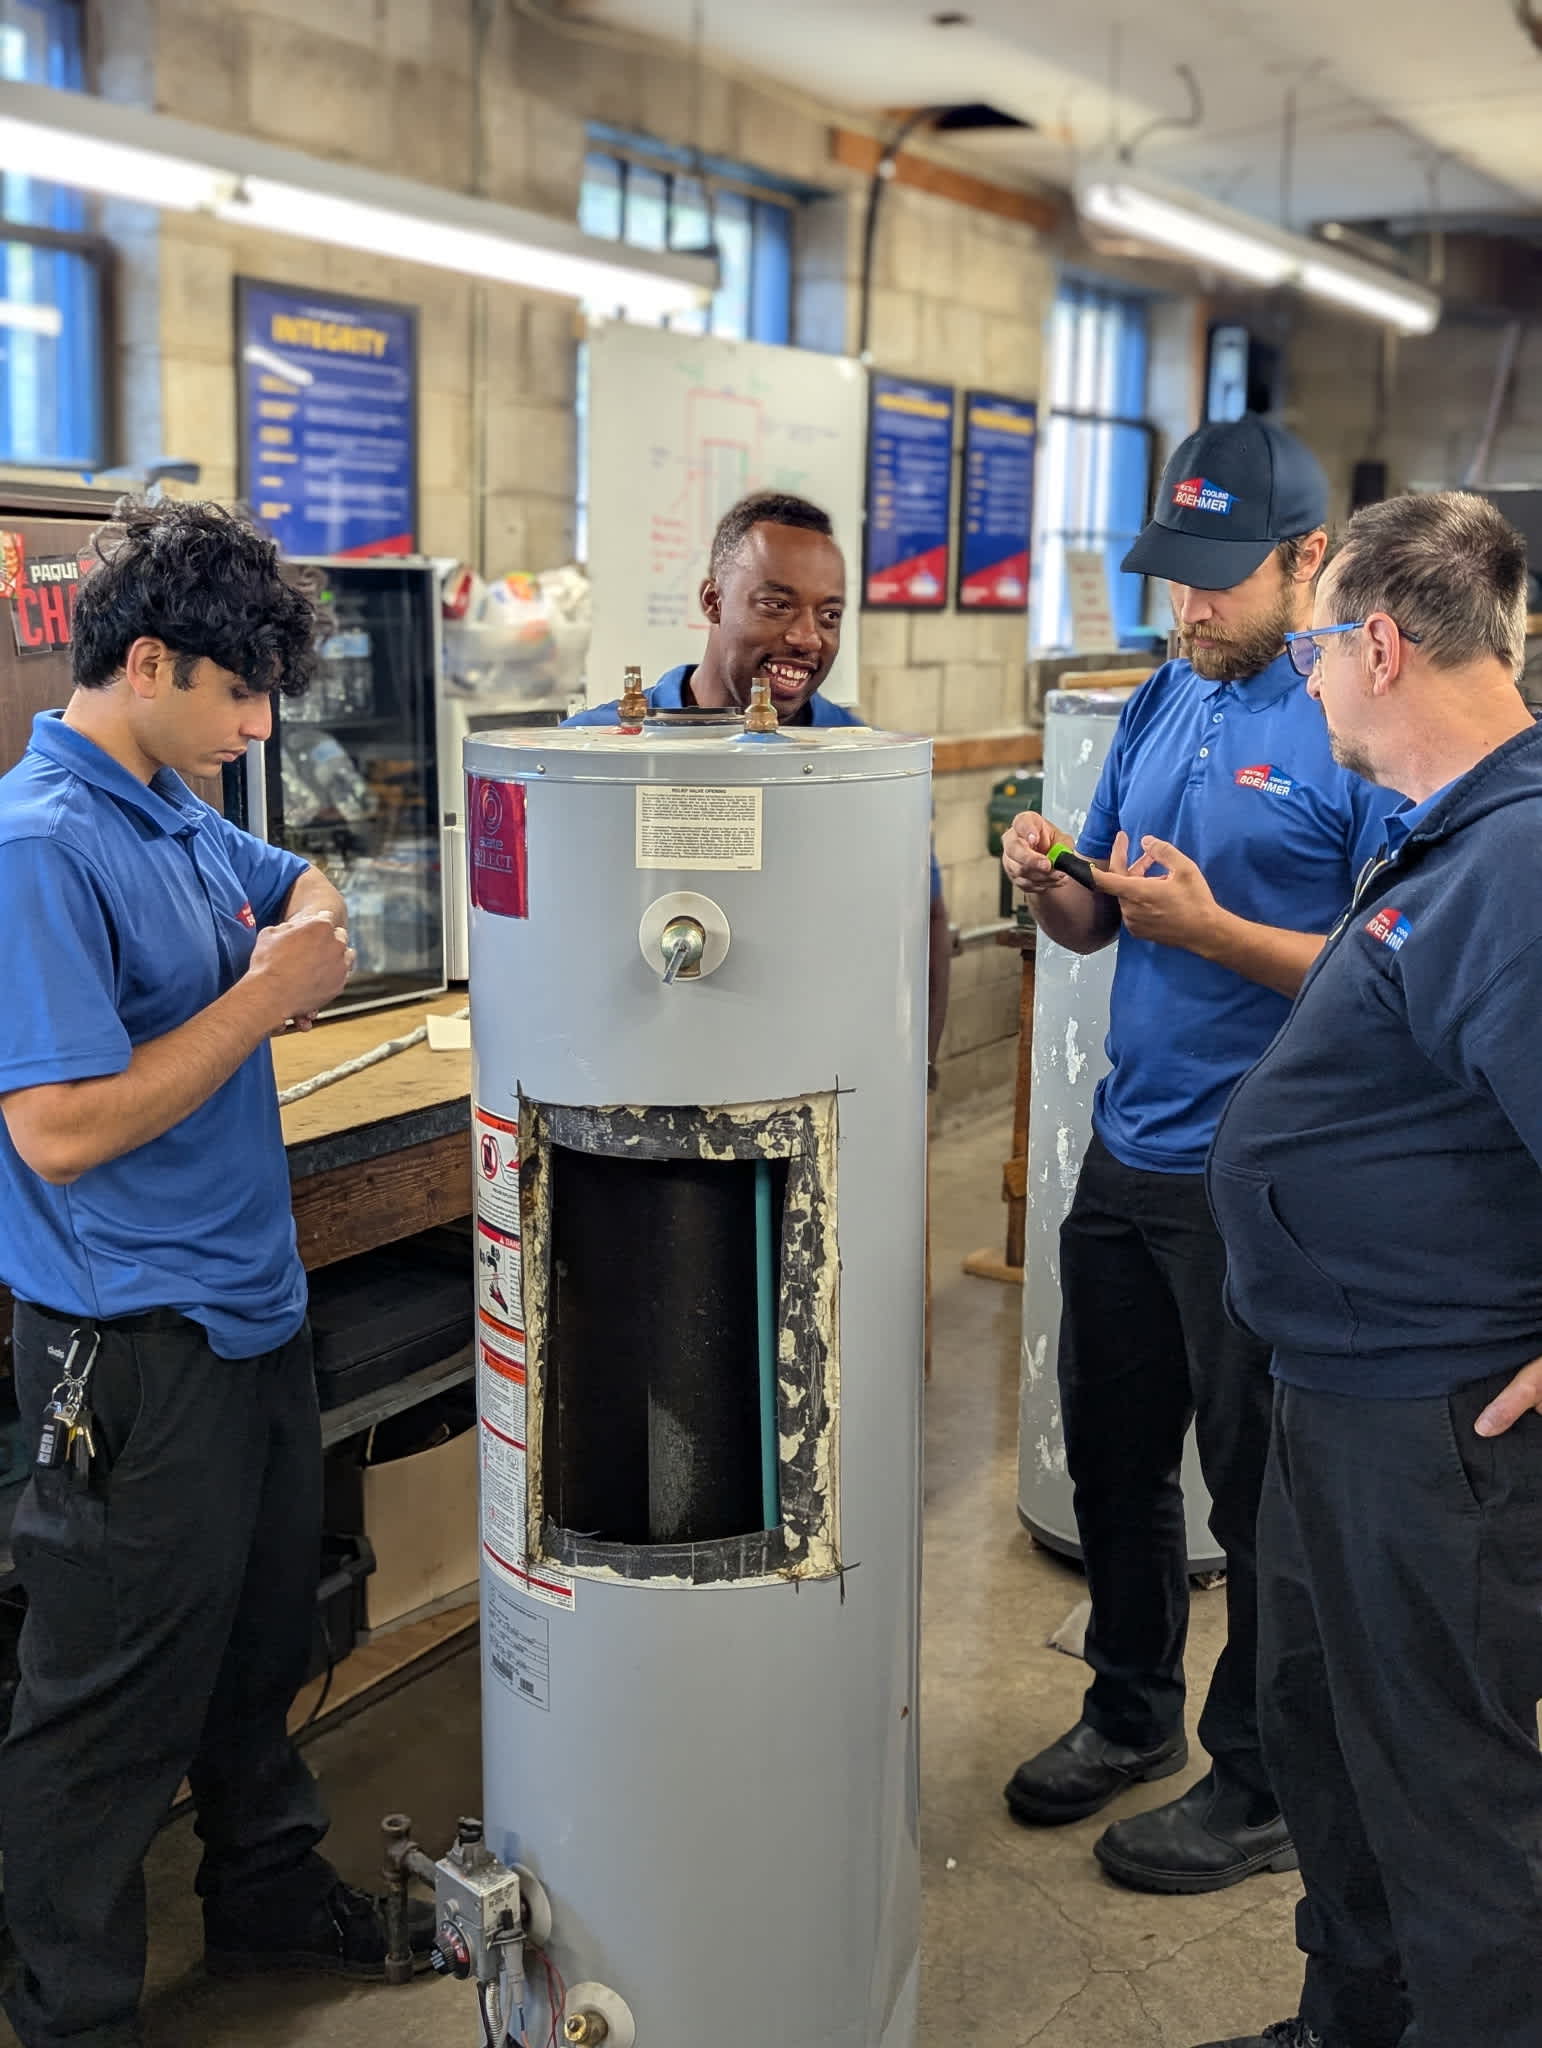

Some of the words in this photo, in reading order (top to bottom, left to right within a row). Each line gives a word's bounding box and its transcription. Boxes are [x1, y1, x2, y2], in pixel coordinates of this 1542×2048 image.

[271, 313, 388, 359] INTEGRITY
[1176, 491, 1228, 512] BOEHMER
[1201, 488, 1229, 500] COOLING
[1239, 775, 1290, 796] BOEHMER
